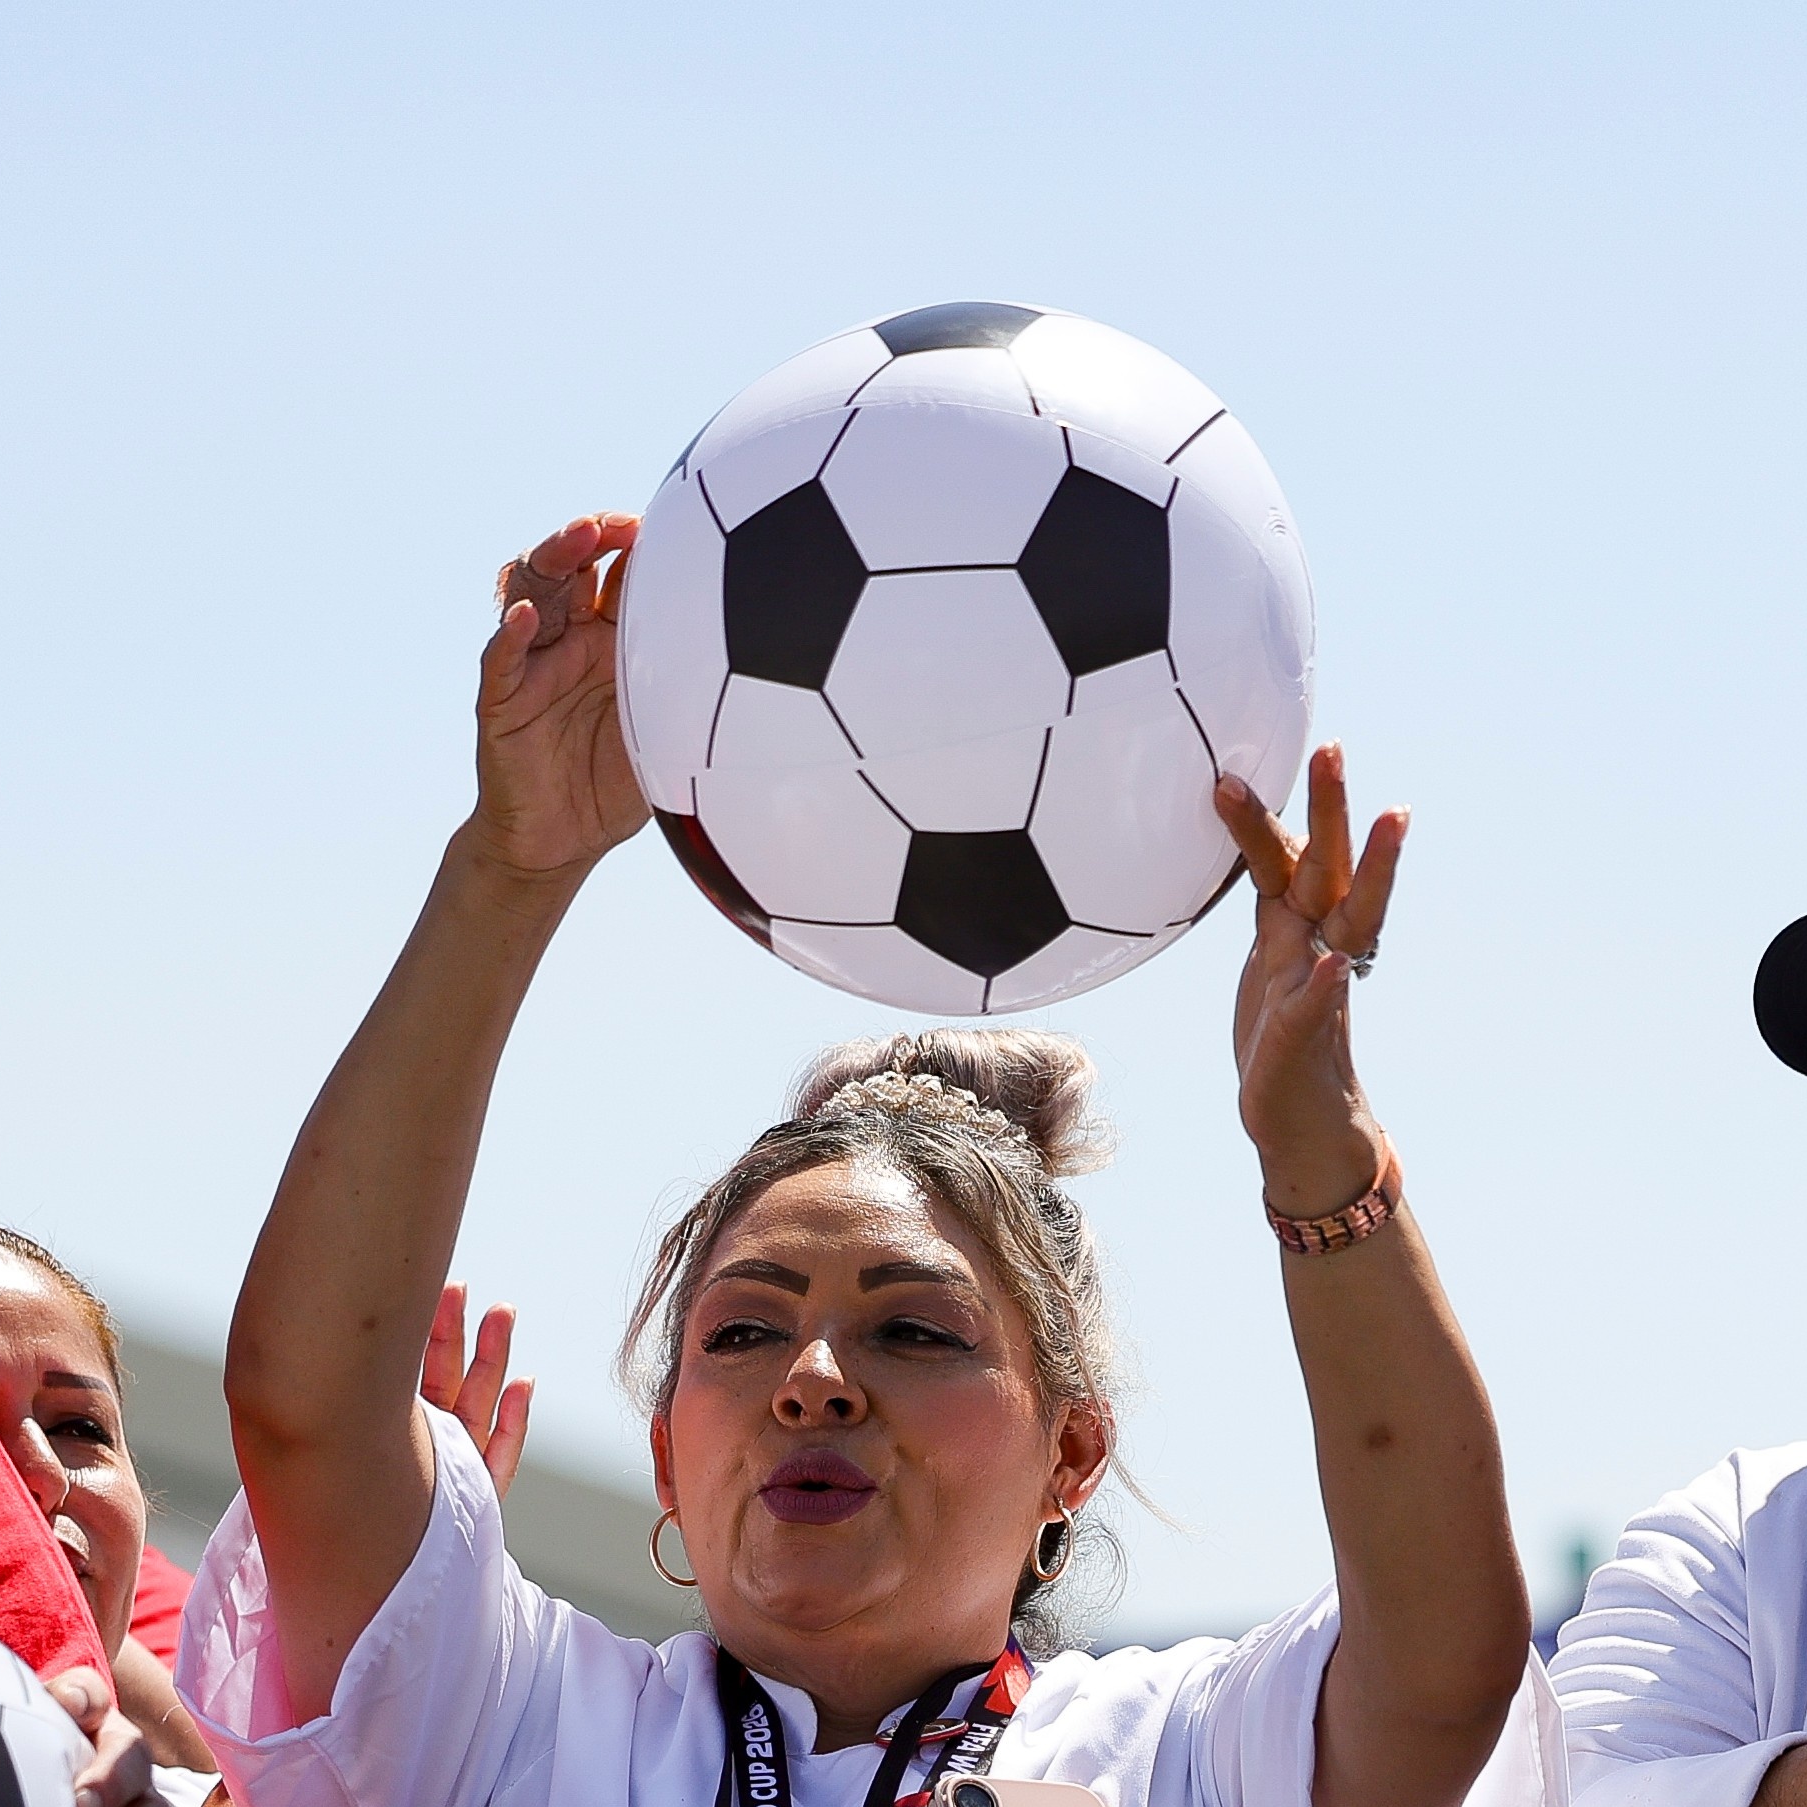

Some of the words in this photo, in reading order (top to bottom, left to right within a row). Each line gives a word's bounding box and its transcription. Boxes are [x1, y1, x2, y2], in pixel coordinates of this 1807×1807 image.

[741, 1702, 774, 1759] 2026
[956, 1722, 999, 1752] FIFA
[748, 1761, 778, 1801] CUP
